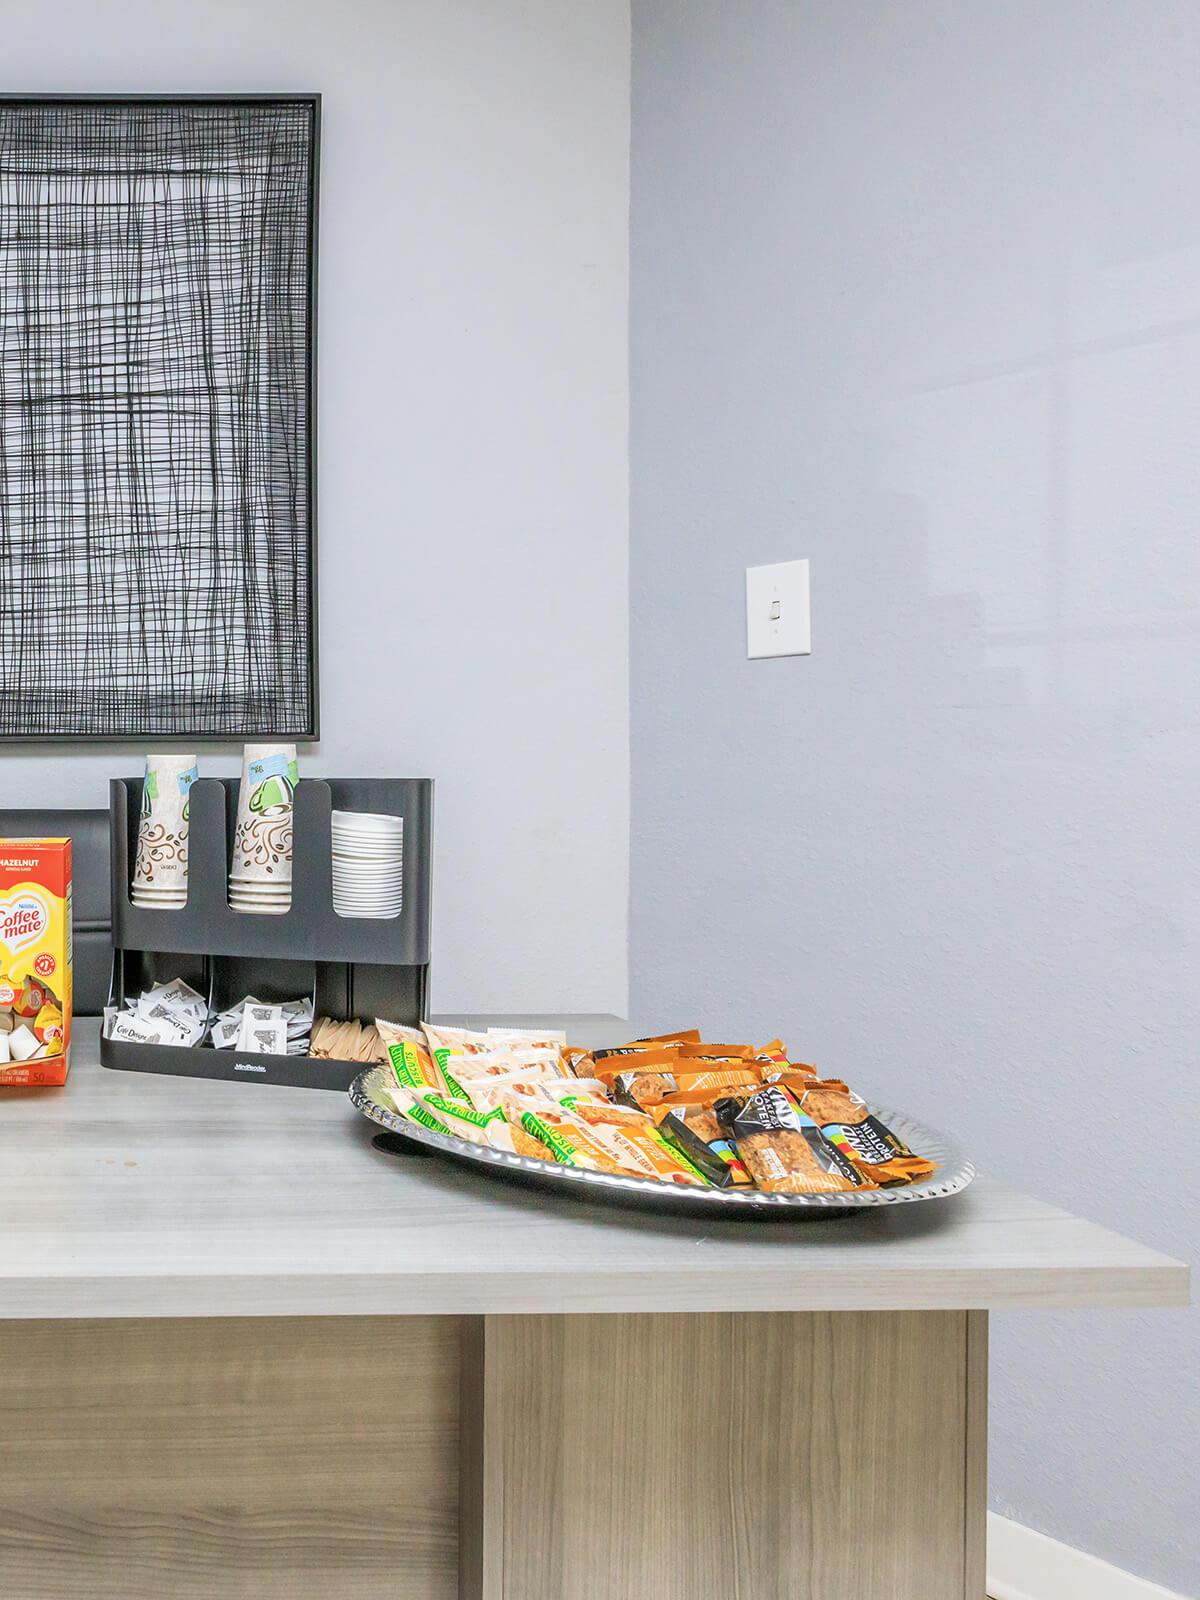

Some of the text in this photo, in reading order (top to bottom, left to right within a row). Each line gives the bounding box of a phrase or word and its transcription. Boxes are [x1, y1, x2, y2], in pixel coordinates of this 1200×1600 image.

[4, 920, 42, 939] mate
[406, 1051, 423, 1085] BISCUITS
[860, 1122, 893, 1160] PROTEIN
